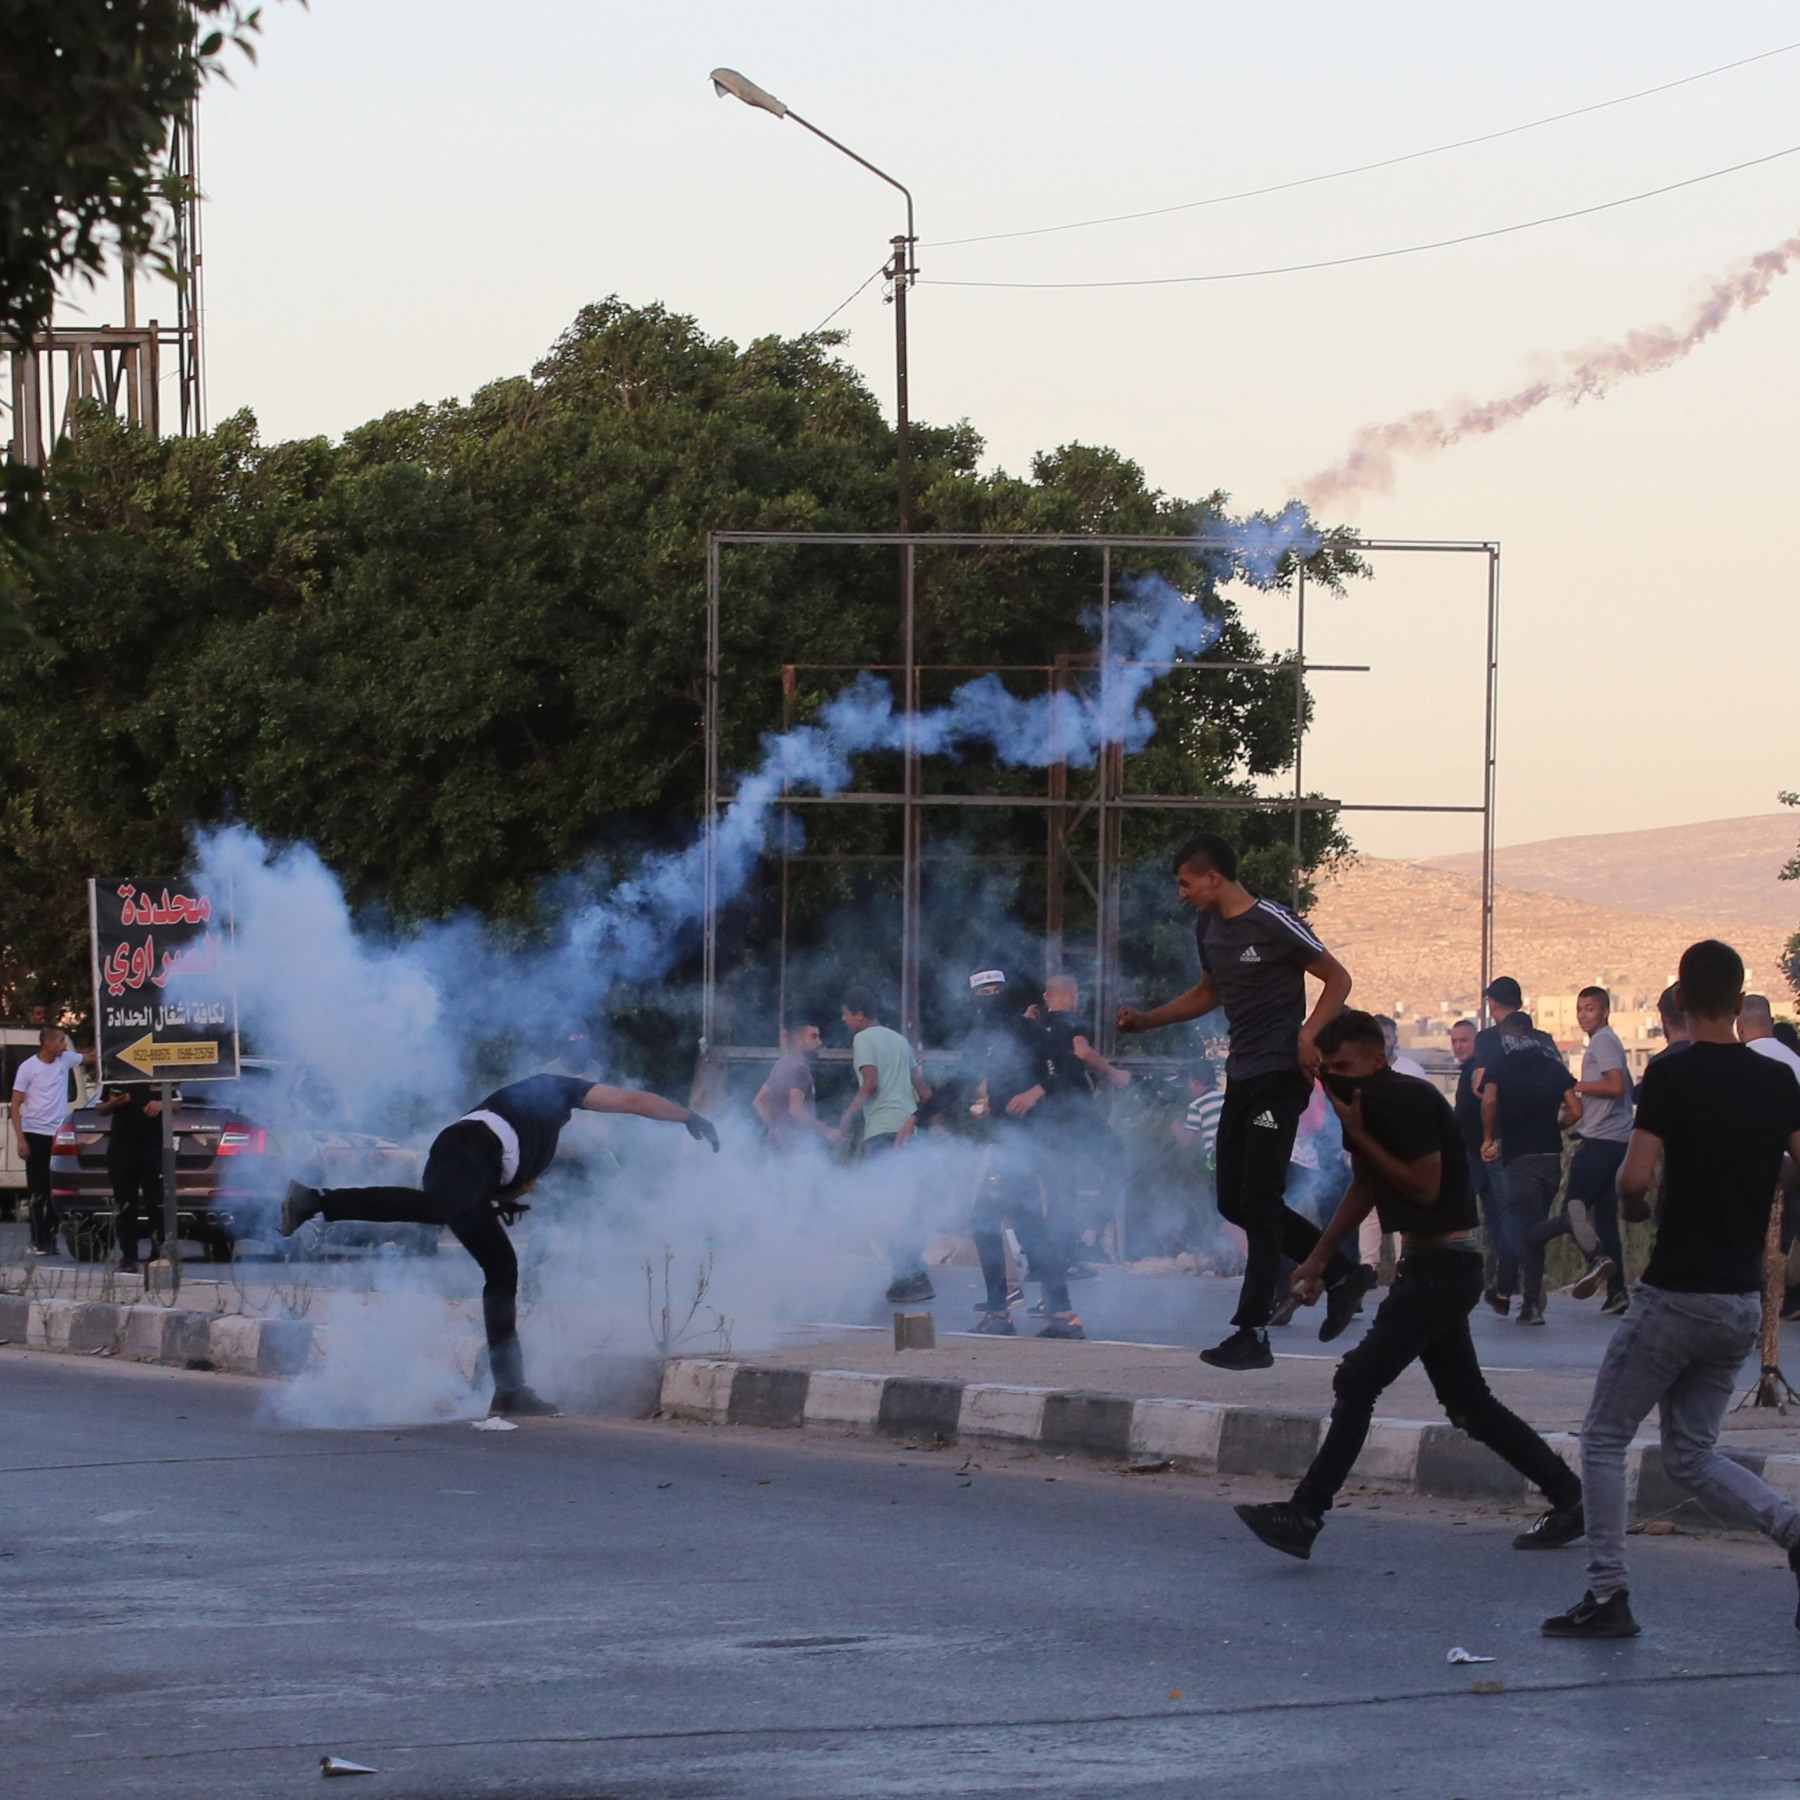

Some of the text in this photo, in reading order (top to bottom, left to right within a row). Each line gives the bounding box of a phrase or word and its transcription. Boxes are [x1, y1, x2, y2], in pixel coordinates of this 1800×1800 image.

[117, 884, 212, 925] محددة
[106, 1006, 153, 1027] الحدادة
[1253, 1118, 1279, 1130] adidas
